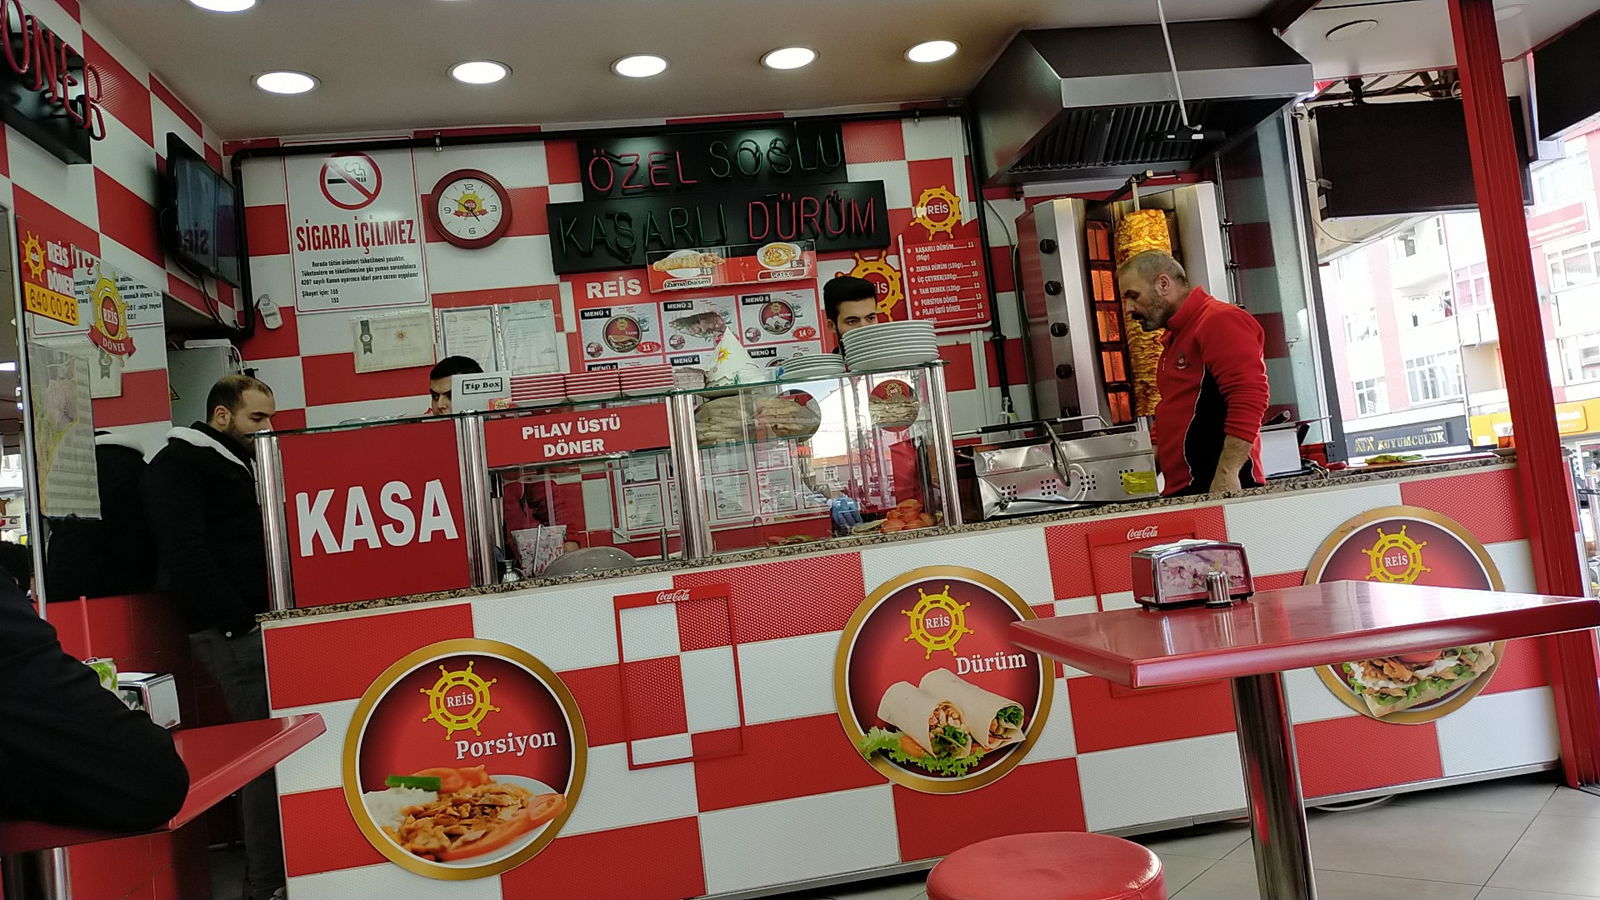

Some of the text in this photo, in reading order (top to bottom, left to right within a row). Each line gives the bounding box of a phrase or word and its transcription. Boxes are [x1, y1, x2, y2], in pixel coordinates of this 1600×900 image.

[588, 122, 842, 192] ÖZEL SOSLU
[748, 190, 875, 240] DÜRÜM
[927, 204, 949, 215] REİS
[296, 214, 416, 254] SİGARA İÇİLMEZ
[47, 240, 69, 270] REİS
[586, 276, 642, 300] REİS
[30, 289, 47, 313] 640
[51, 294, 62, 318] 00
[64, 299, 77, 321] 28
[667, 302, 686, 310] MENÜ
[745, 295, 763, 303] MENÜ
[103, 306, 118, 325] REİS
[584, 309, 603, 317] MENÜ
[798, 329, 807, 337] 14
[102, 337, 126, 352] DÖNER
[751, 349, 769, 357] MENÜ
[673, 357, 693, 365] MENÜ
[465, 381, 499, 391] Tip Box
[577, 414, 622, 435] ÜSTÜ
[543, 438, 605, 458] DÖNER
[1377, 431, 1447, 451] KUYUMCULUK
[295, 479, 459, 558] KASA
[1384, 553, 1408, 568] REİS
[925, 614, 951, 630] REİS
[955, 649, 1028, 676] Dürüm
[446, 690, 474, 708] REİS
[455, 729, 558, 761] Porsiyon
